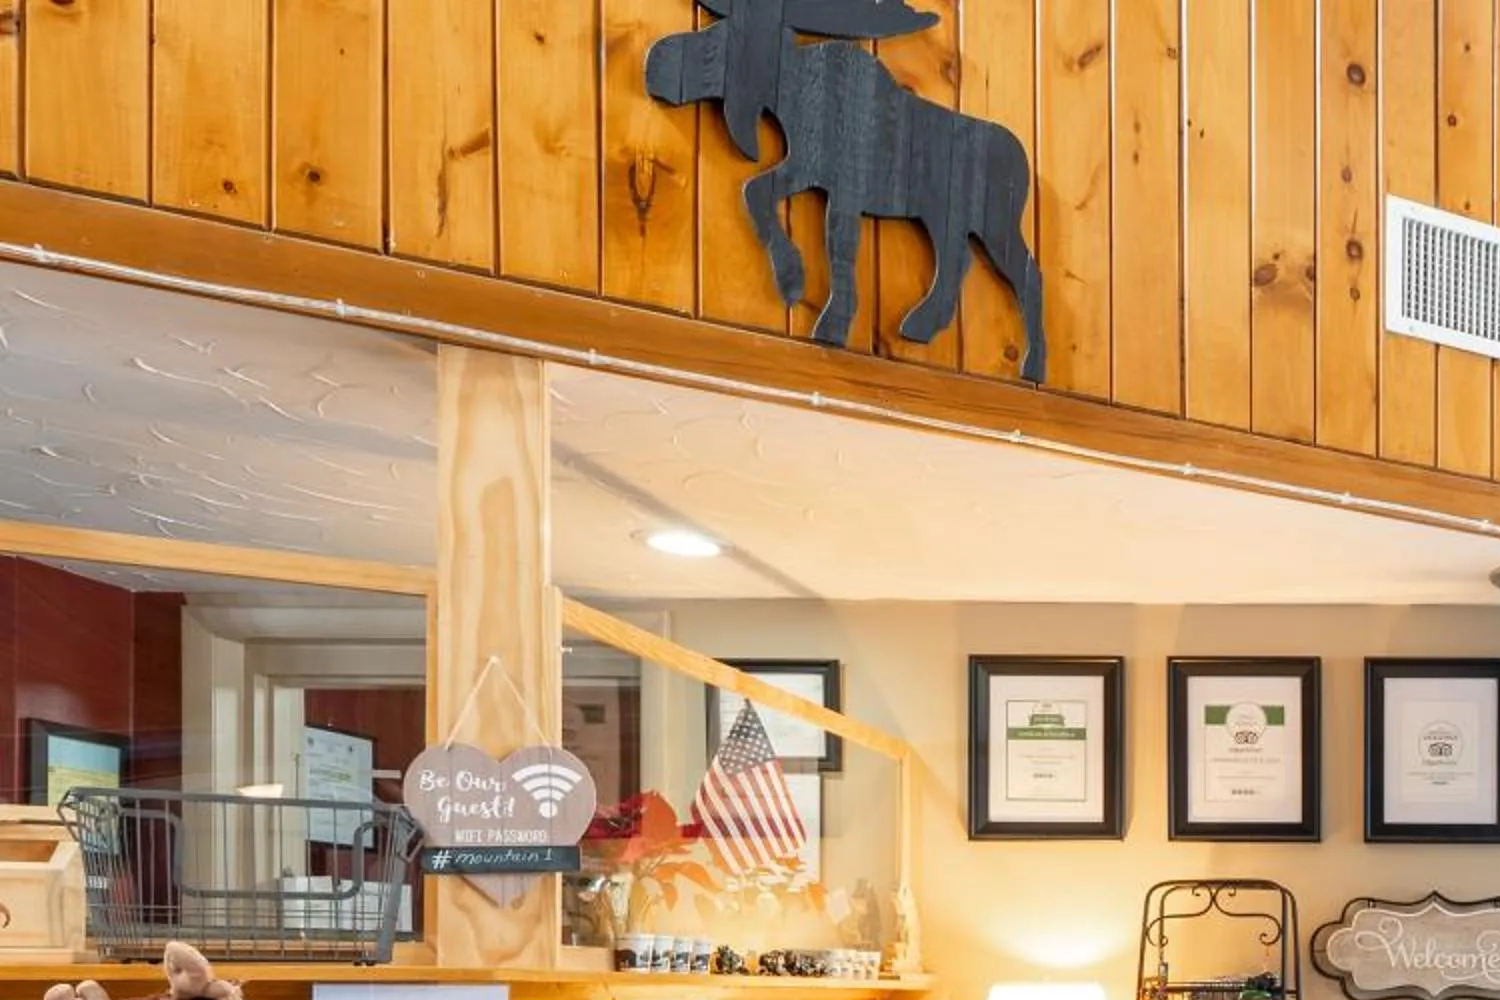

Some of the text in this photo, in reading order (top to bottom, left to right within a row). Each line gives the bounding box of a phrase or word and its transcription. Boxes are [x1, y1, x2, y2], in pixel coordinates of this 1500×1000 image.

[419, 769, 507, 792] Be Our
[487, 829, 548, 844] PASSWORD
